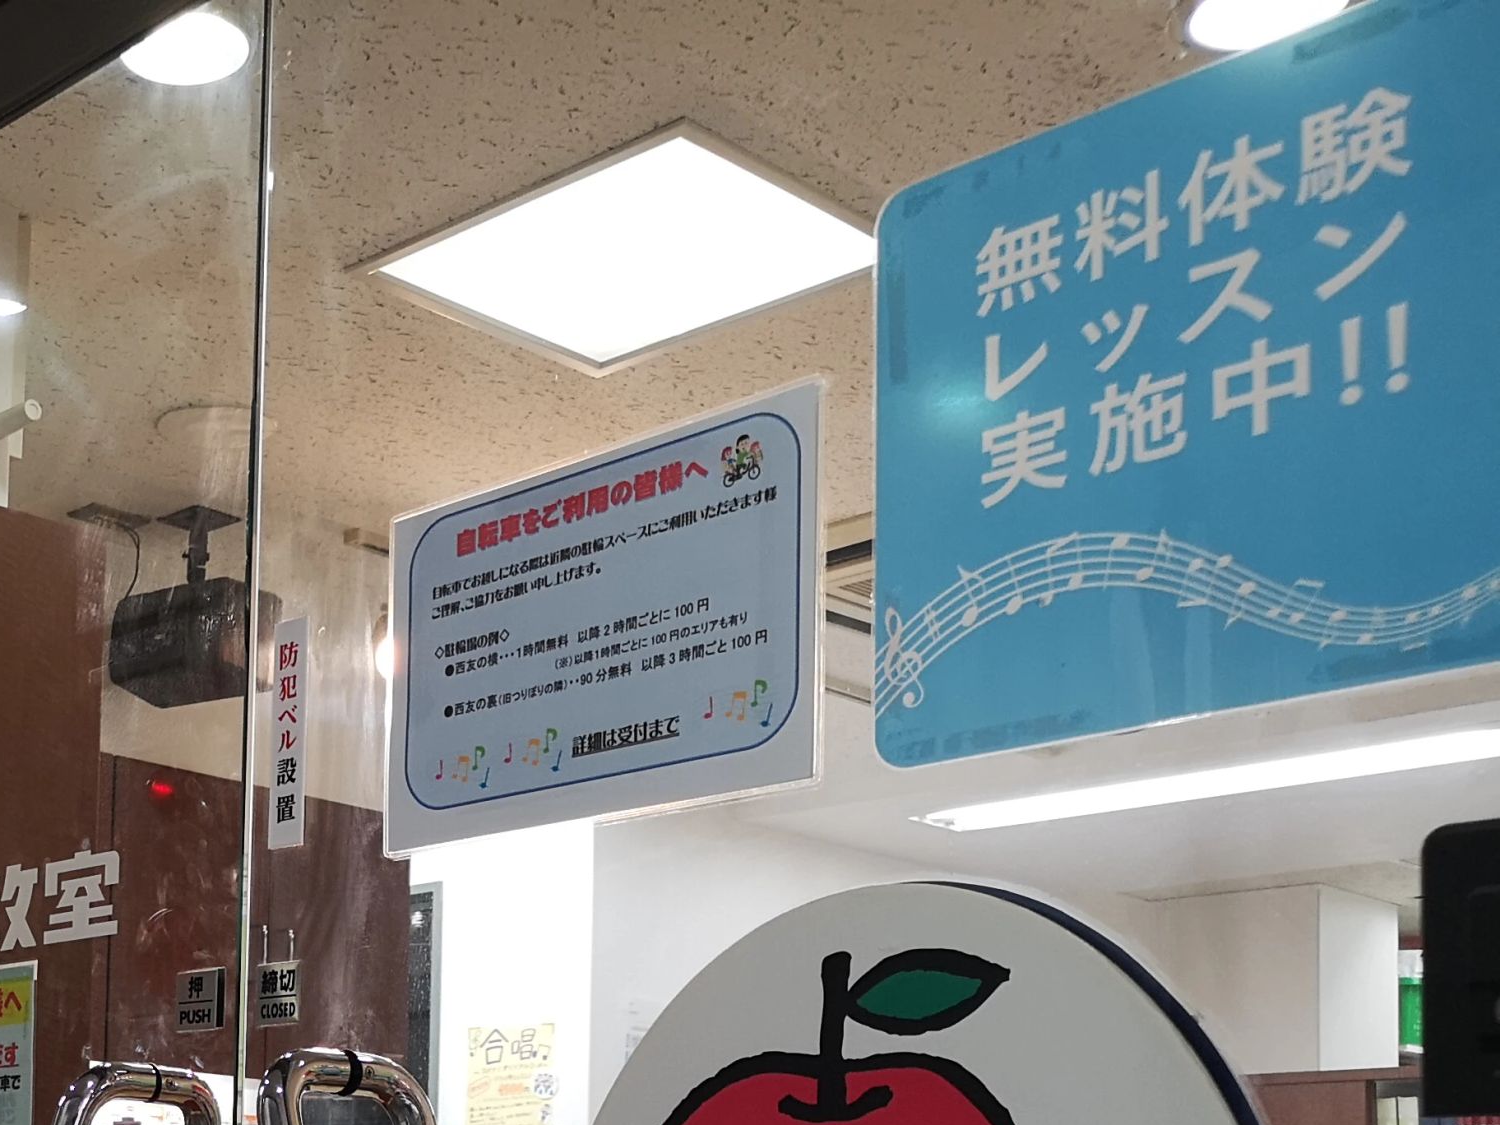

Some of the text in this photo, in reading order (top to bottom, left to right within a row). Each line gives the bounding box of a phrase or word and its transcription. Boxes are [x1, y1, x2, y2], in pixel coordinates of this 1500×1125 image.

[975, 86, 1414, 318] 無料体験
[983, 210, 1407, 402] レッスン
[455, 459, 710, 558] 自転車をご利用の皆様へ
[430, 564, 603, 621] ご理解、ご協力をお願い申し上げます。
[276, 641, 299, 825] 防犯ベル設置
[572, 715, 681, 757] 詳細は受付まで
[187, 976, 203, 998] 押
[261, 969, 295, 993] 締切
[179, 1009, 211, 1025] PUSH
[260, 1001, 296, 1021] CLOSED
